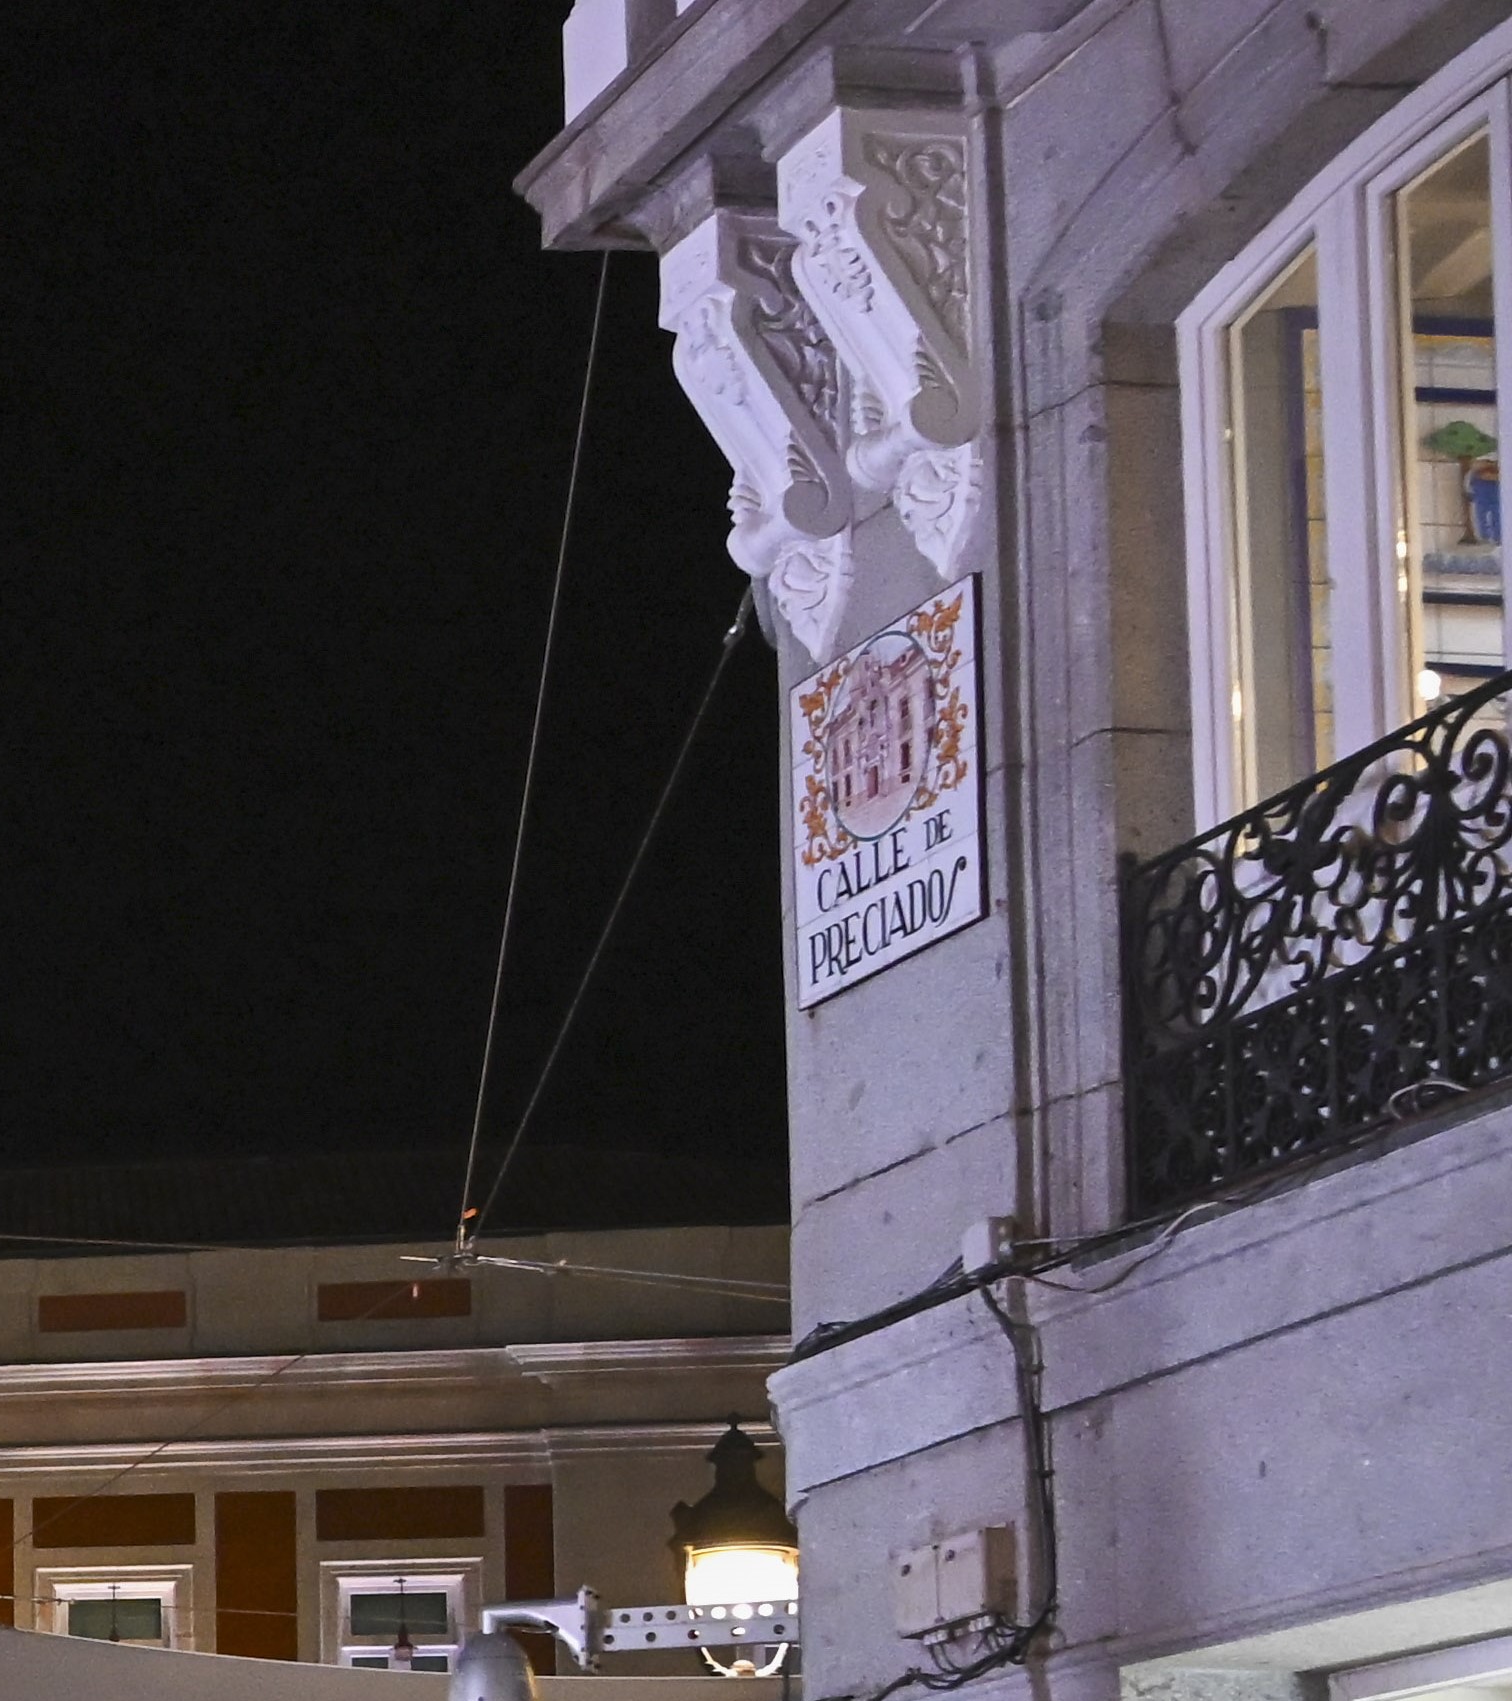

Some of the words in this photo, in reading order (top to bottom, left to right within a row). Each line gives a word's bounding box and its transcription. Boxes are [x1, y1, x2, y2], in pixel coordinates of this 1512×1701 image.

[817, 827, 910, 913] CALLE
[925, 808, 952, 853] DE
[809, 855, 967, 985] PRECIADOS
